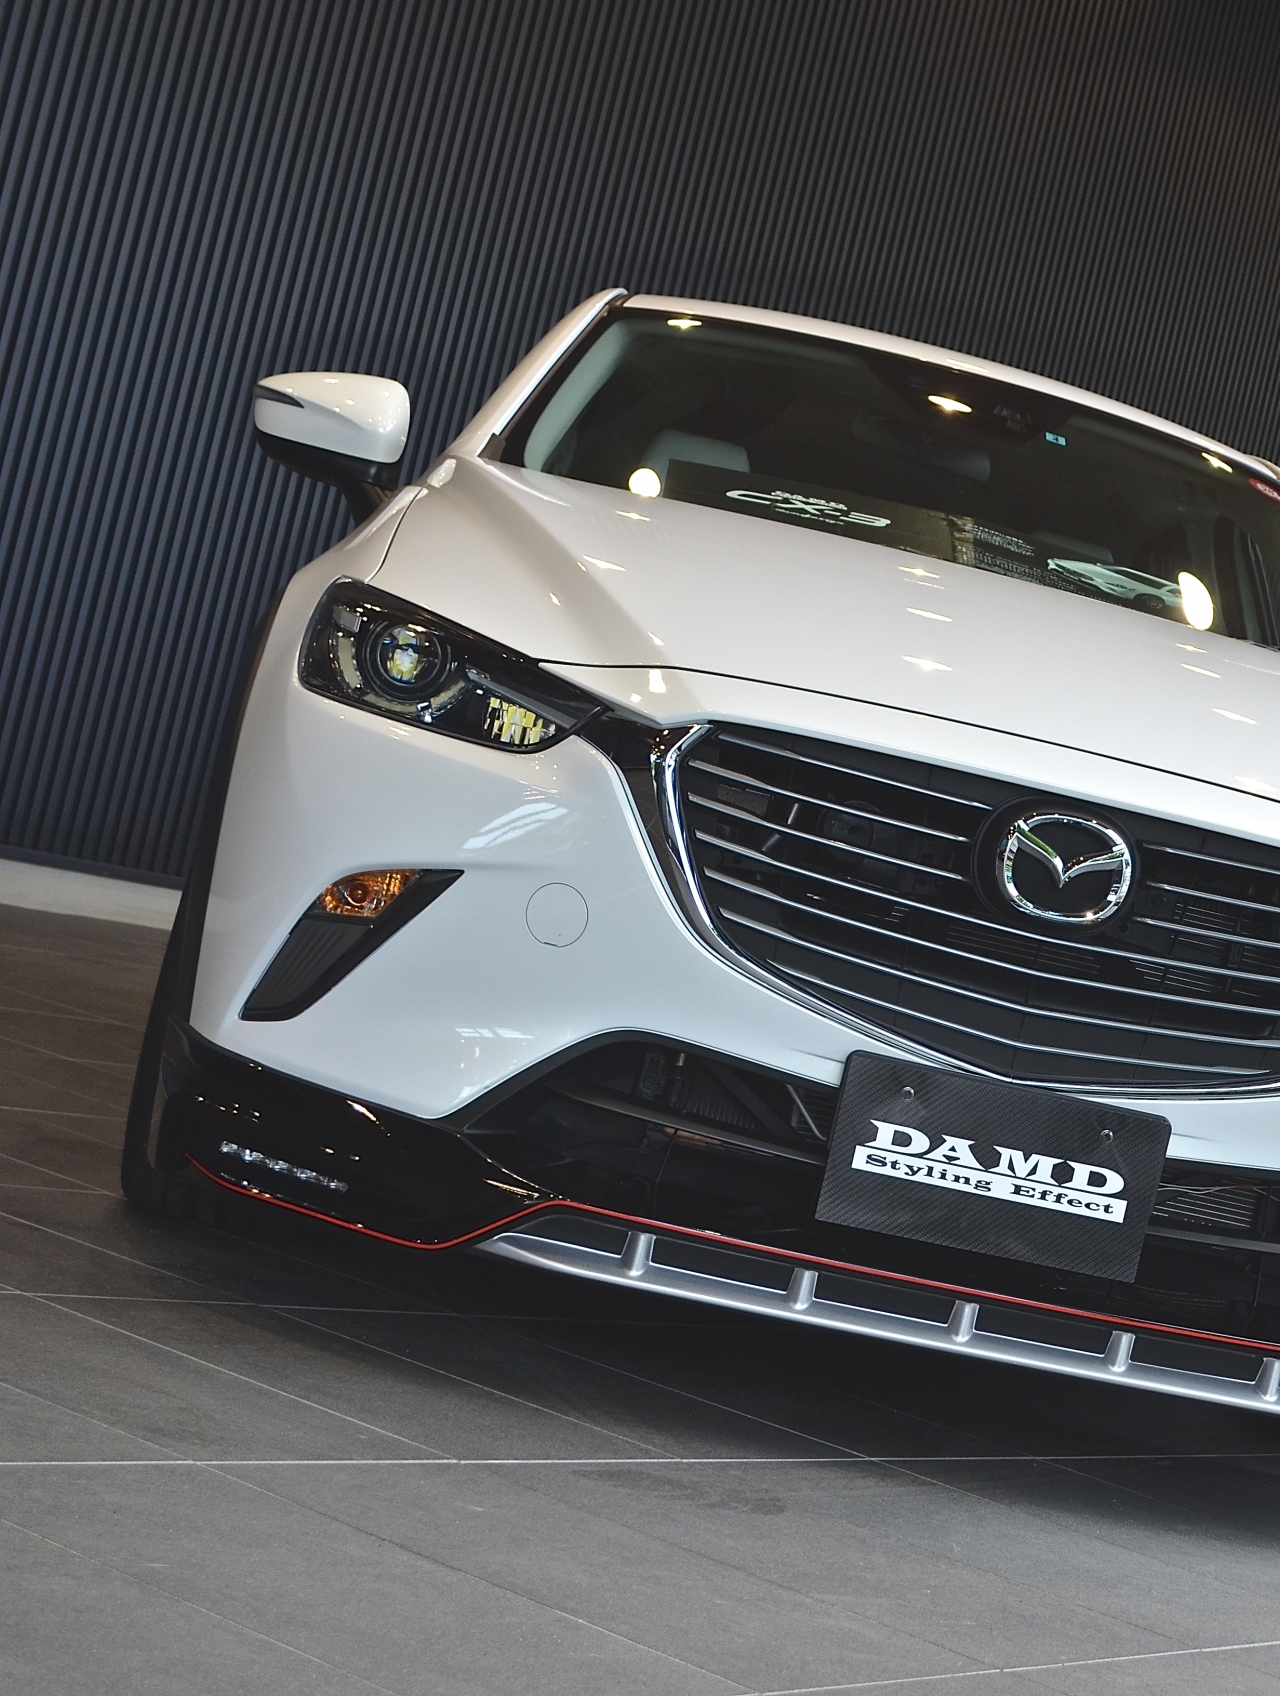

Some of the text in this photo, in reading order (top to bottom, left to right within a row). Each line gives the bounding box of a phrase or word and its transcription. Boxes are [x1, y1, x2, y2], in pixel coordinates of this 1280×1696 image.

[725, 489, 892, 528] CX-3
[863, 1119, 1127, 1196] DAMD
[864, 1153, 1115, 1216] Styling Effect
